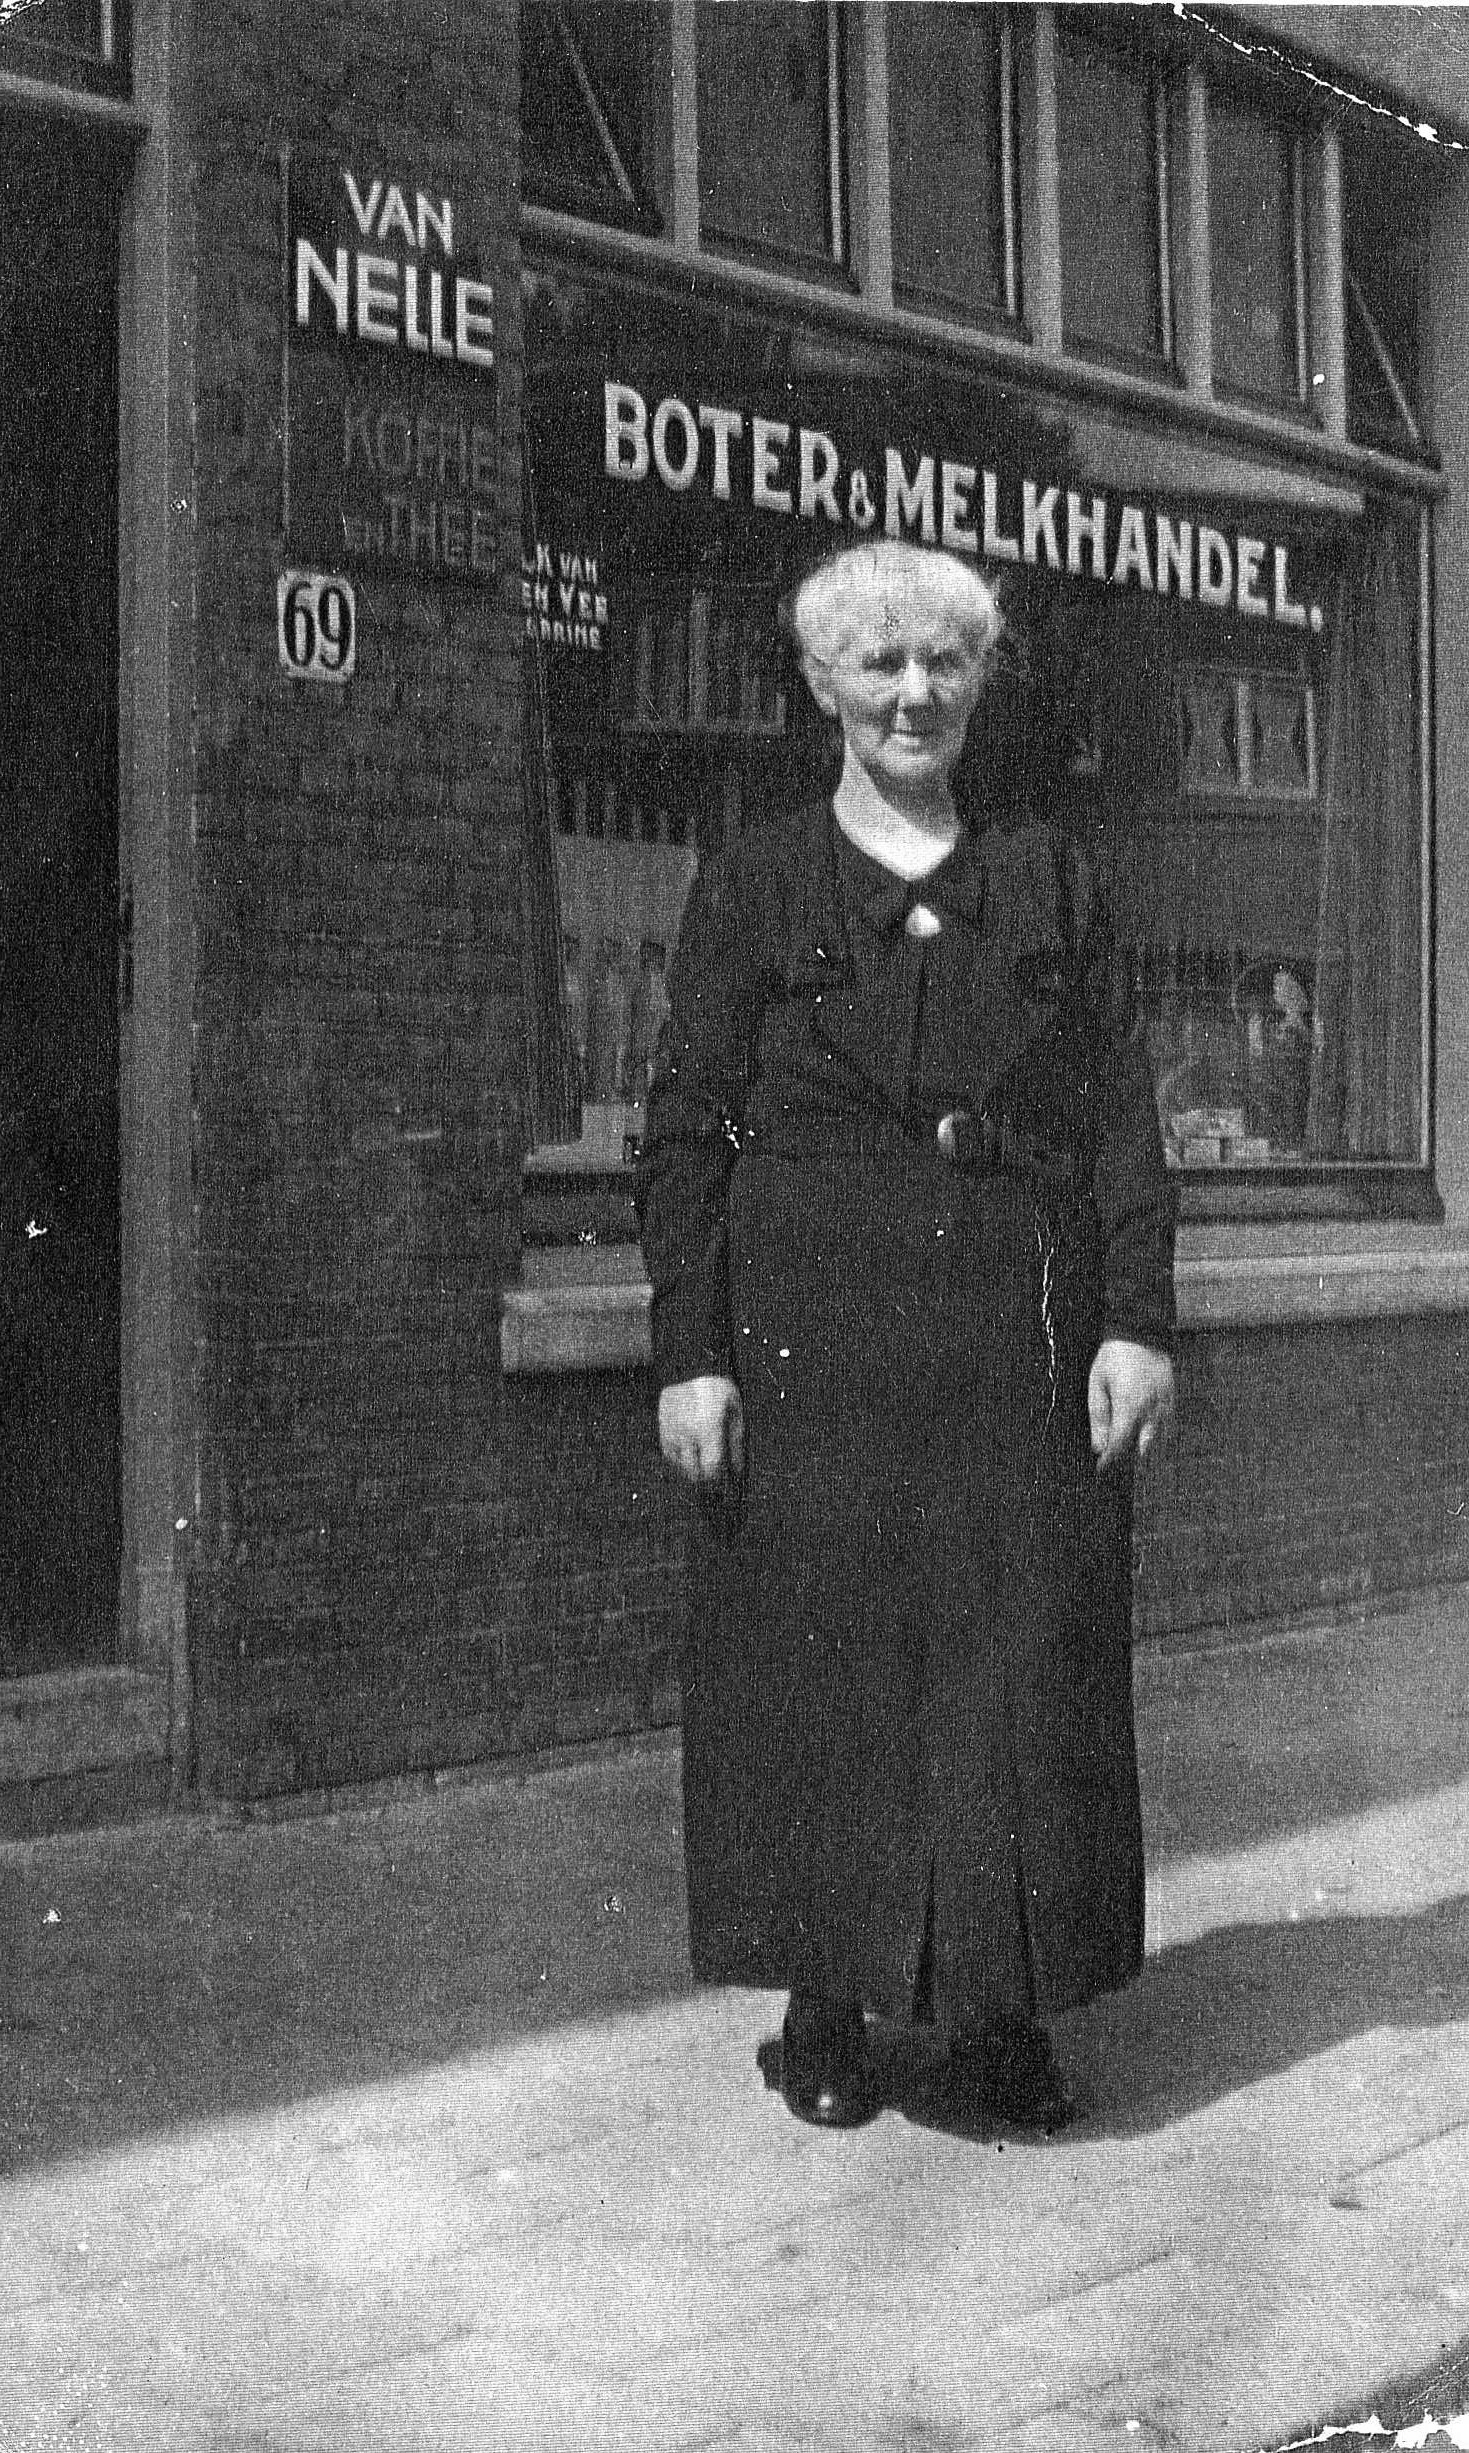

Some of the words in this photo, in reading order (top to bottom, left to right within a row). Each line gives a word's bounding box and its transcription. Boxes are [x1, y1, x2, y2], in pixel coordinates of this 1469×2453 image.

[341, 170, 453, 256] VAN
[296, 238, 494, 367] NELLE
[383, 493, 497, 573] THEE
[604, 383, 840, 522] BOTER
[848, 470, 876, 529] &
[885, 448, 1323, 633] MELKHANDEL.
[284, 580, 351, 671] 69
